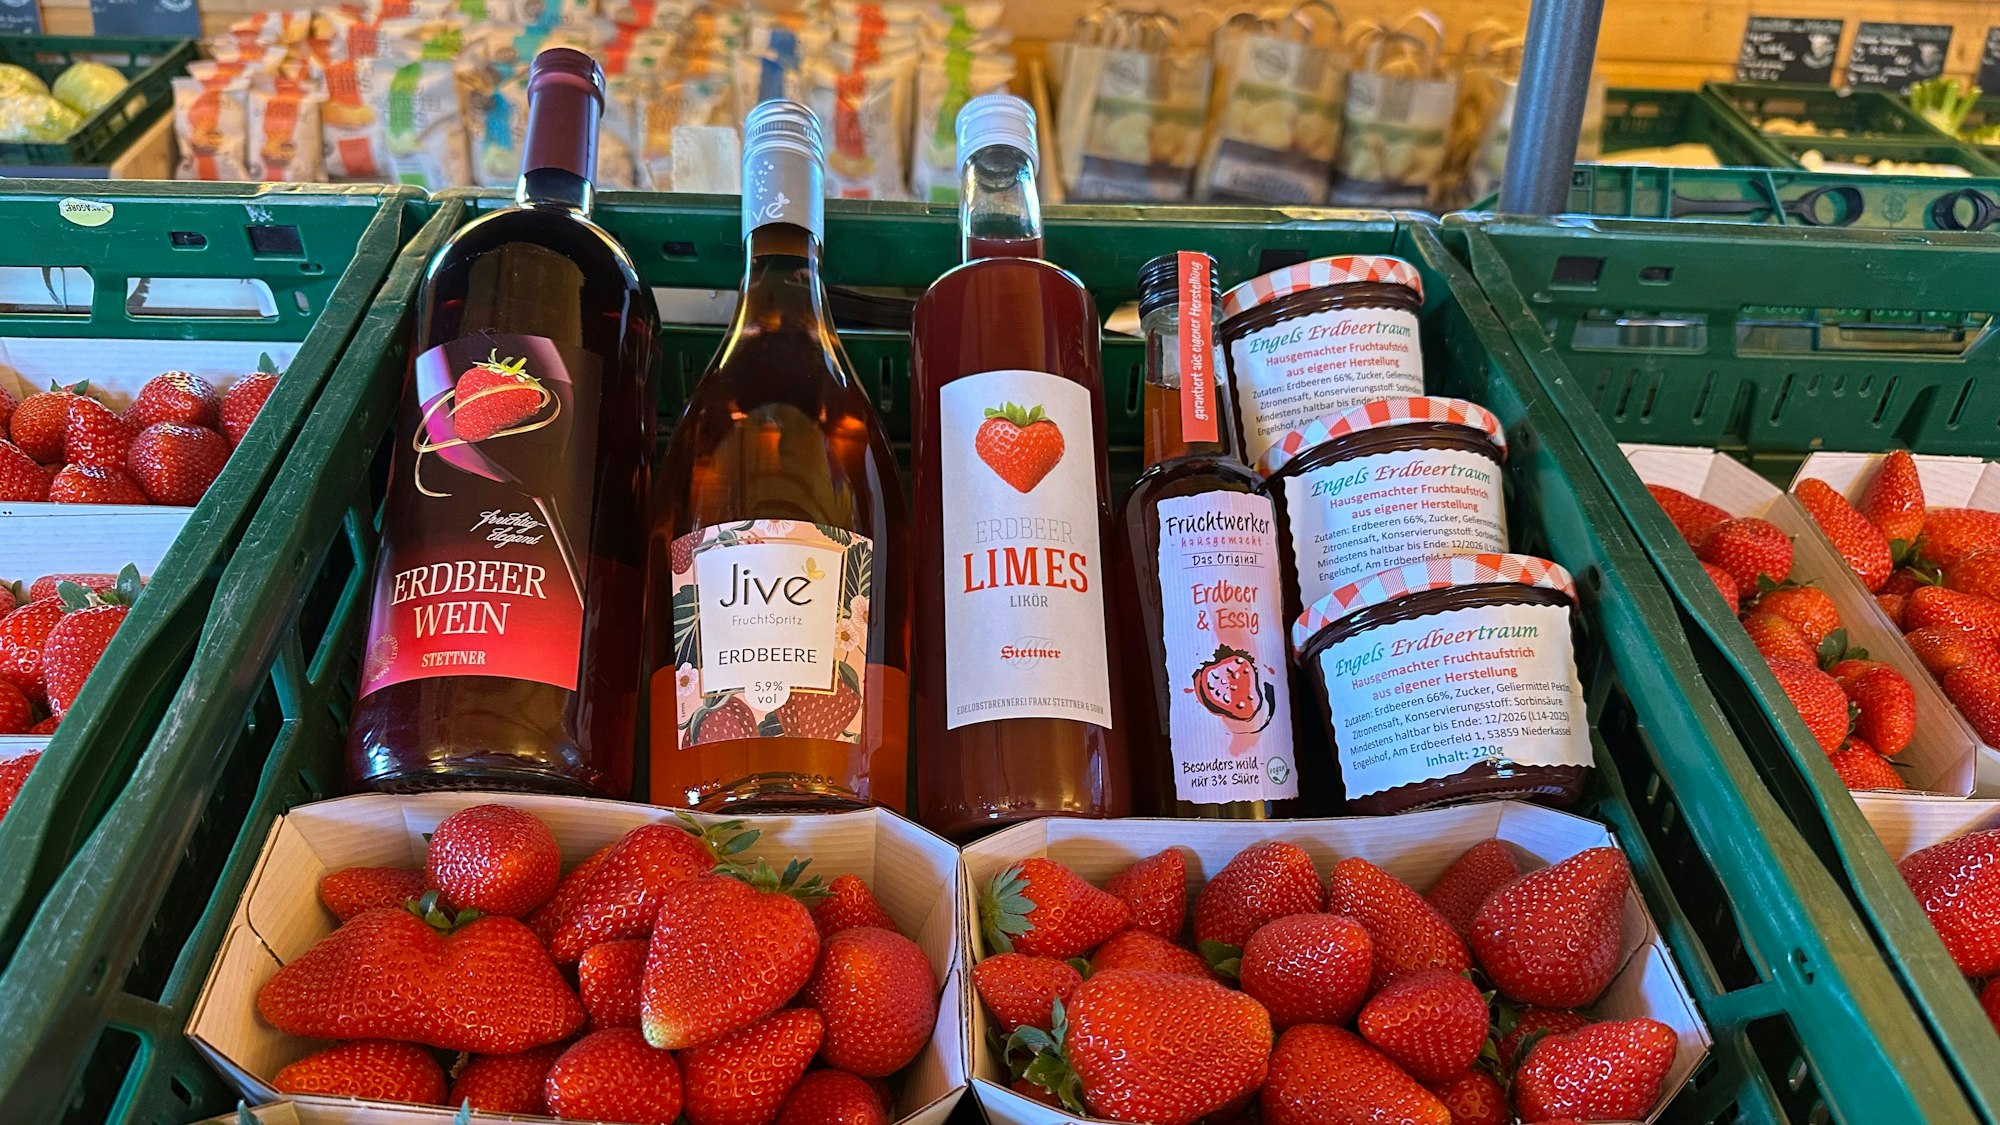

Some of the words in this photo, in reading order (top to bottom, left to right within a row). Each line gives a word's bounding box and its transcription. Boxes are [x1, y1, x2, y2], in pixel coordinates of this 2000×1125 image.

[1188, 261, 1203, 318] Herstellung
[1191, 317, 1204, 352] eigener
[1249, 326, 1303, 354] Engels
[1308, 319, 1411, 341] Erdbeertraum
[1266, 346, 1346, 366] Hausgemachter
[1350, 342, 1409, 353] Fruchtaufstrich
[1286, 367, 1304, 378] aus
[1307, 360, 1347, 375] eigener
[1350, 356, 1400, 369] Herstellung
[1190, 372, 1208, 420] garantiert
[1253, 384, 1286, 399] Zutaten:
[1286, 377, 1332, 391] Erdbeeren
[1333, 373, 1355, 383] 66%,
[1355, 371, 1385, 380] Zucker,
[1260, 393, 1312, 410] Zitronensaft,
[1314, 384, 1395, 399] Konservierungsstoff:
[1256, 409, 1301, 424] Mindestens
[1303, 402, 1334, 416] haltbar
[1337, 400, 1349, 409] bis
[1351, 397, 1373, 407] Ende:
[1257, 422, 1297, 436] Engelshof,
[1298, 418, 1313, 427] Am
[1311, 467, 1369, 498] Engels
[1375, 461, 1491, 484] Erdbeertraum
[1330, 486, 1417, 509] Hausgemachter
[1421, 484, 1489, 499] Fruchtaufstrich
[1352, 509, 1371, 519] aus
[1374, 502, 1418, 517] eigener
[1421, 501, 1479, 513] Herstellung
[976, 517, 1075, 544] ERDBEER
[1314, 527, 1350, 543] Zutaten:
[1352, 518, 1401, 533] Erdbeeren
[1403, 515, 1427, 524] 66%,
[1428, 513, 1461, 523] Zucker,
[1322, 535, 1379, 554] Zitronensaft,
[1381, 525, 1473, 541] Konservierungsstoff:
[1191, 554, 1212, 566] Das
[1217, 553, 1257, 566] Original
[1317, 550, 1368, 568] Mindestens
[1370, 543, 1404, 556] haltbar
[1406, 540, 1421, 550] bis
[1423, 540, 1449, 549] Ende:
[1451, 540, 1483, 550] 12/2026
[1319, 565, 1363, 581] Engelshof,
[1365, 560, 1381, 571] Am
[1383, 553, 1440, 567] Erdbeerfeld
[391, 560, 547, 606] ERDBEER
[963, 547, 1088, 593] LIMES
[719, 563, 812, 607] Jive
[1191, 579, 1258, 605] Erdbeer
[1010, 593, 1049, 608] LIKÖR
[413, 601, 511, 638] WEIN
[732, 614, 802, 626] FruchtSpritz
[1196, 610, 1210, 631] &
[1215, 608, 1259, 635] Essig
[421, 651, 486, 667] STETTNER
[718, 648, 817, 665] ERDBEERE
[1000, 644, 1061, 660] Stettner
[1335, 642, 1385, 678] Engels
[1391, 624, 1539, 658] Erdbeertraum
[1352, 658, 1440, 690] Hausgemachter
[1443, 647, 1535, 666] Fruchtaufstrich
[754, 681, 783, 692] 5,9%
[1372, 688, 1392, 701] aus
[1394, 677, 1441, 697] eigener
[1445, 665, 1518, 684] Herstellung
[758, 694, 777, 704] vol
[957, 697, 1027, 715] EDELOBSTBRENNEREI
[1028, 697, 1051, 706] FRANZ
[1052, 697, 1085, 709] STETTNER
[1344, 709, 1373, 728] Zutaten:
[1375, 698, 1425, 717] Erdbeeren
[1427, 691, 1453, 703] 66%,
[1454, 684, 1494, 698] Zucker,
[1496, 681, 1550, 693] Geliermittel
[1352, 717, 1403, 740] Zitronensaft,
[1404, 697, 1512, 724] Konservierungsstoff:
[1514, 696, 1563, 707] Sorbinsäure
[1350, 735, 1393, 756] Mindestens
[1395, 726, 1431, 742] haltbar
[1433, 721, 1449, 732] bis
[1452, 716, 1481, 729] Ende:
[1484, 711, 1527, 725] 12/2026
[1528, 711, 1570, 723] (L14-2025)
[1353, 752, 1391, 770] Engelshof,
[1392, 746, 1408, 758] Am
[1410, 733, 1472, 753] Erdbeerfeld
[1475, 732, 1485, 742] 1,
[1487, 729, 1519, 739] 53859
[1521, 726, 1572, 737] Niederkassel
[1426, 752, 1469, 767] Inhalt:
[1471, 745, 1504, 760] 220g
[1182, 758, 1234, 774] Besonders
[1235, 757, 1259, 770] mild
[1269, 765, 1286, 775] vegan
[1211, 774, 1228, 786] 3%
